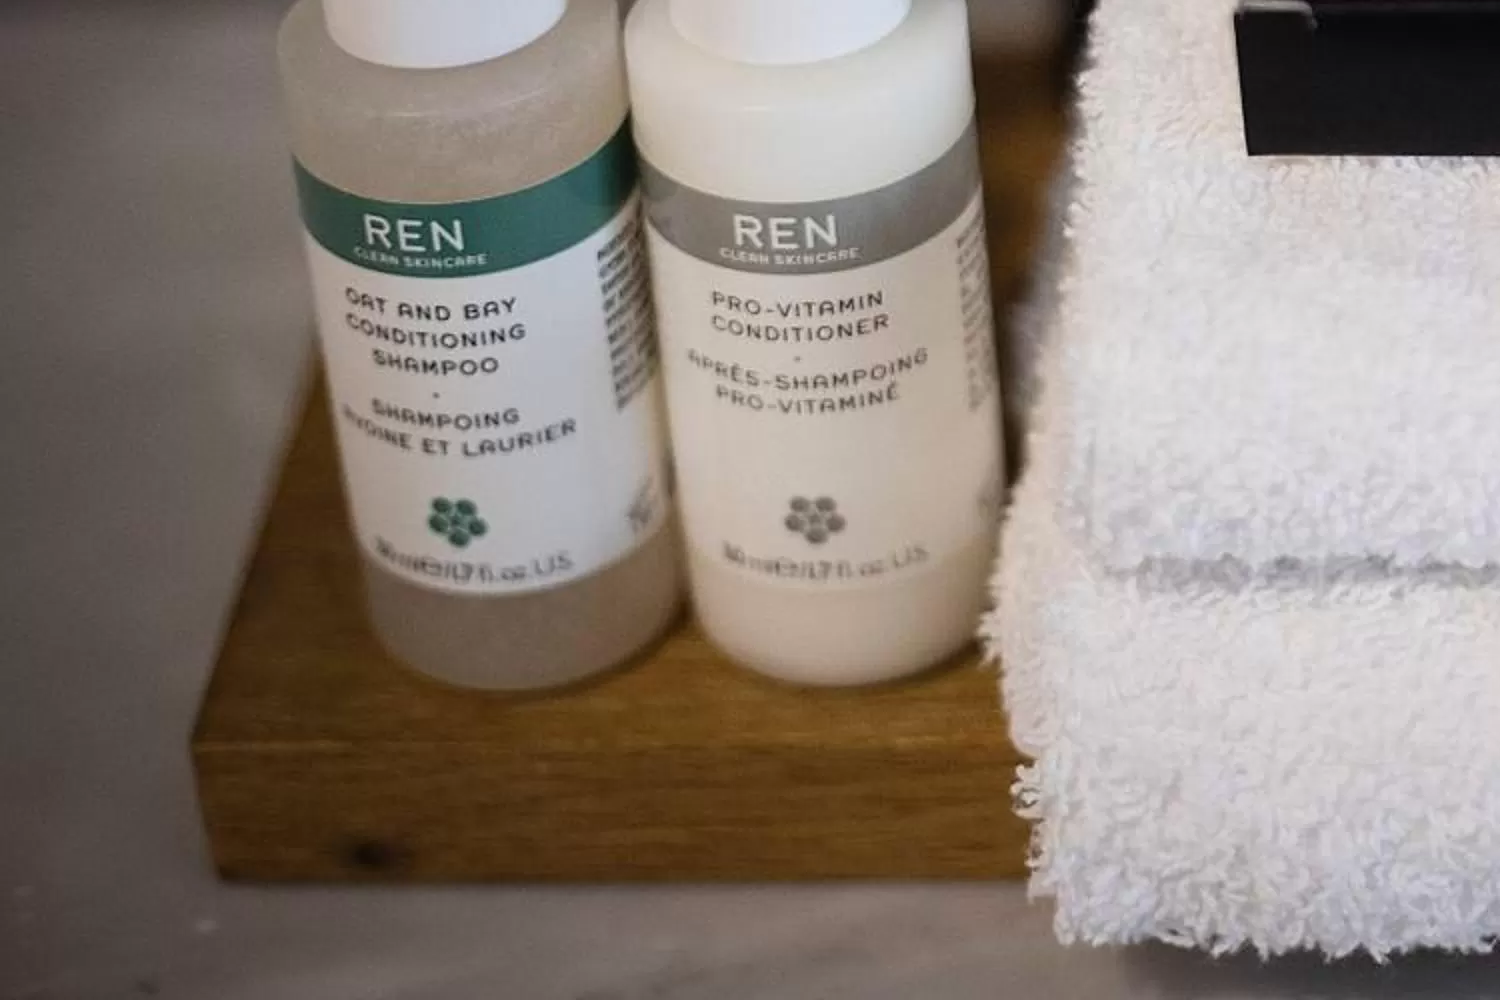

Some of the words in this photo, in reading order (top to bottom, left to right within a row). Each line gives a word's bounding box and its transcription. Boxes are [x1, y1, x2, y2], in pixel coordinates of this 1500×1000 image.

[363, 213, 464, 251] REN
[732, 214, 836, 250] REN
[404, 254, 487, 268] SKINCARE
[721, 247, 769, 264] CLEAN
[775, 248, 859, 266] SKINCARE
[345, 287, 386, 314] OAT
[399, 302, 451, 321] AND
[464, 297, 517, 320] BAY
[712, 290, 883, 318] PRO-VITAMIN
[346, 314, 527, 348] CONDITIONING
[712, 314, 890, 342] CONDITIONER
[372, 349, 499, 377] SHAMPOO
[372, 397, 520, 430] SHAMPOING
[422, 437, 449, 455] ET
[463, 417, 576, 457] LAURIER
